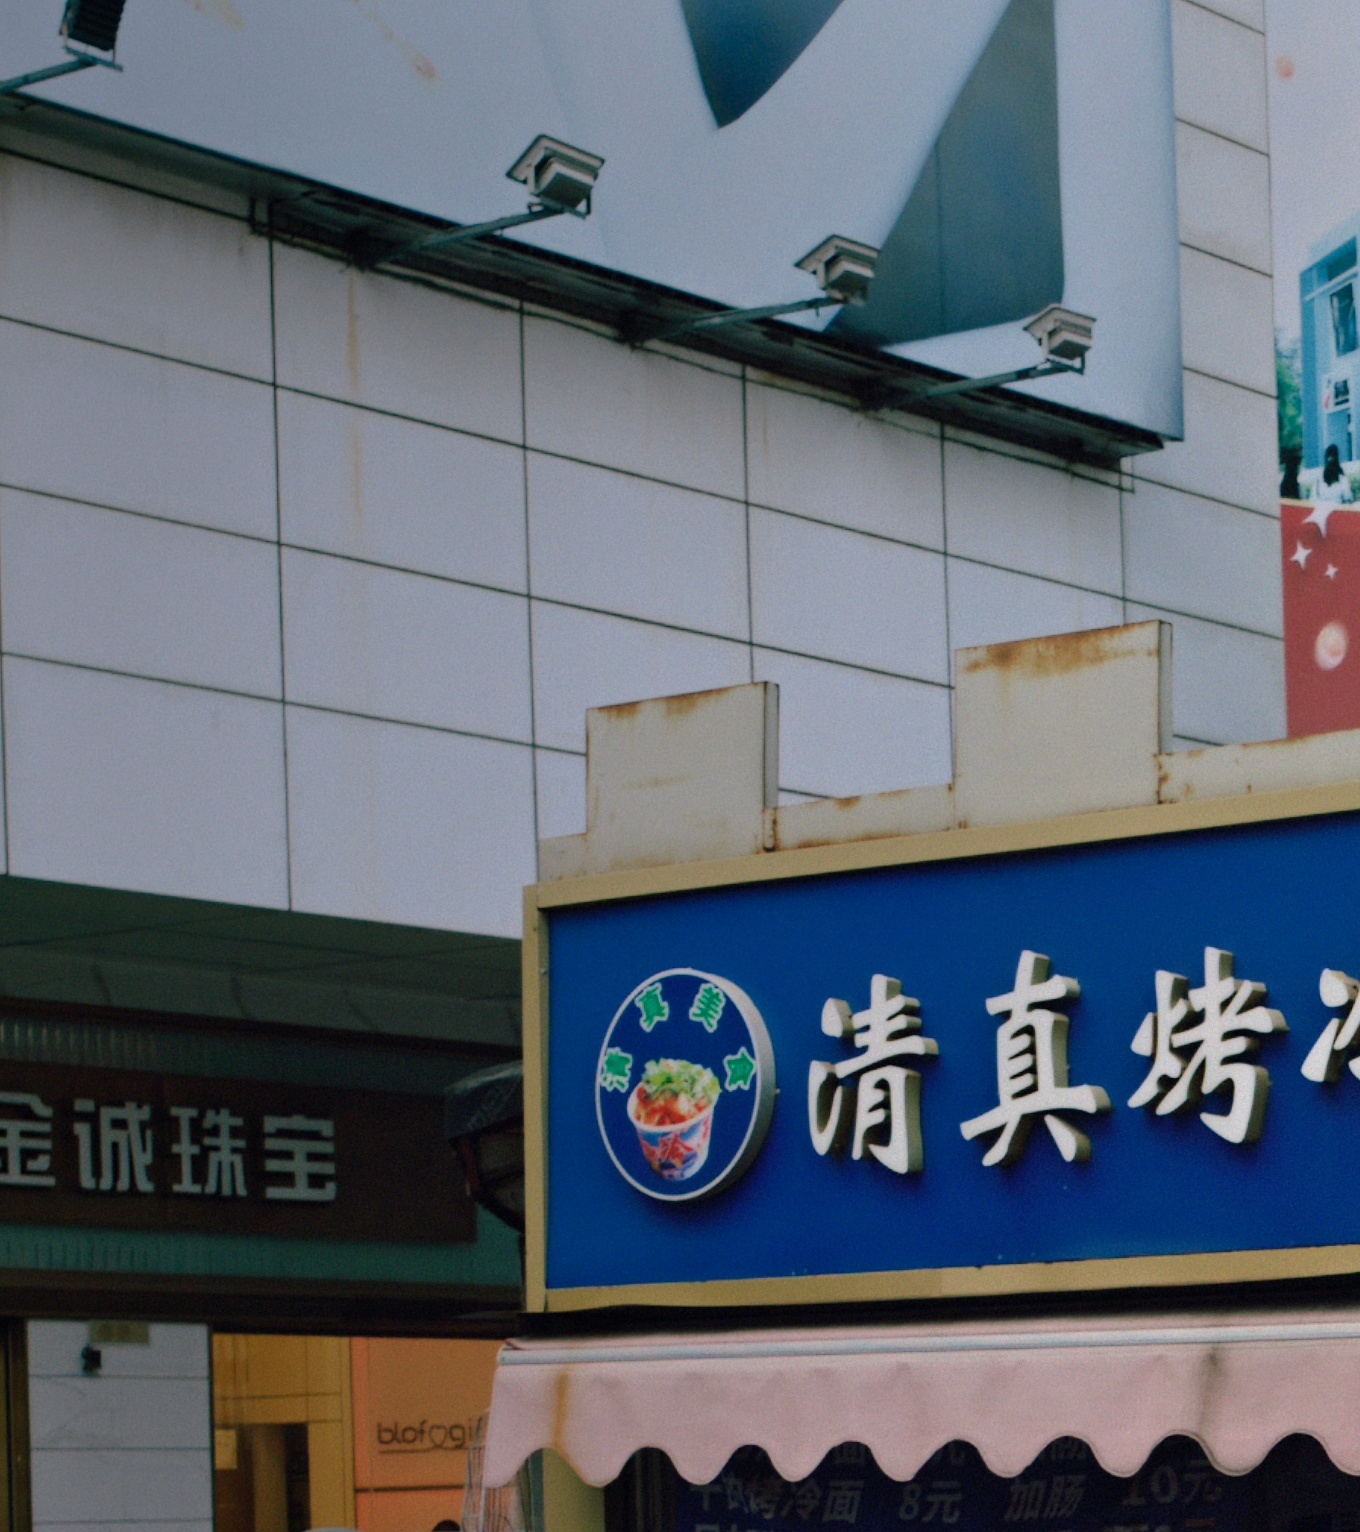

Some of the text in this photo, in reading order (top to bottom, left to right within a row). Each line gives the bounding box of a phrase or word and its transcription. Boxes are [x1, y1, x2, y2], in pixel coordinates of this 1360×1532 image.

[0, 1092, 338, 1201] 金诚珠宝
[899, 1480, 964, 1524] 8元
[1003, 1474, 1087, 1522] 加肠
